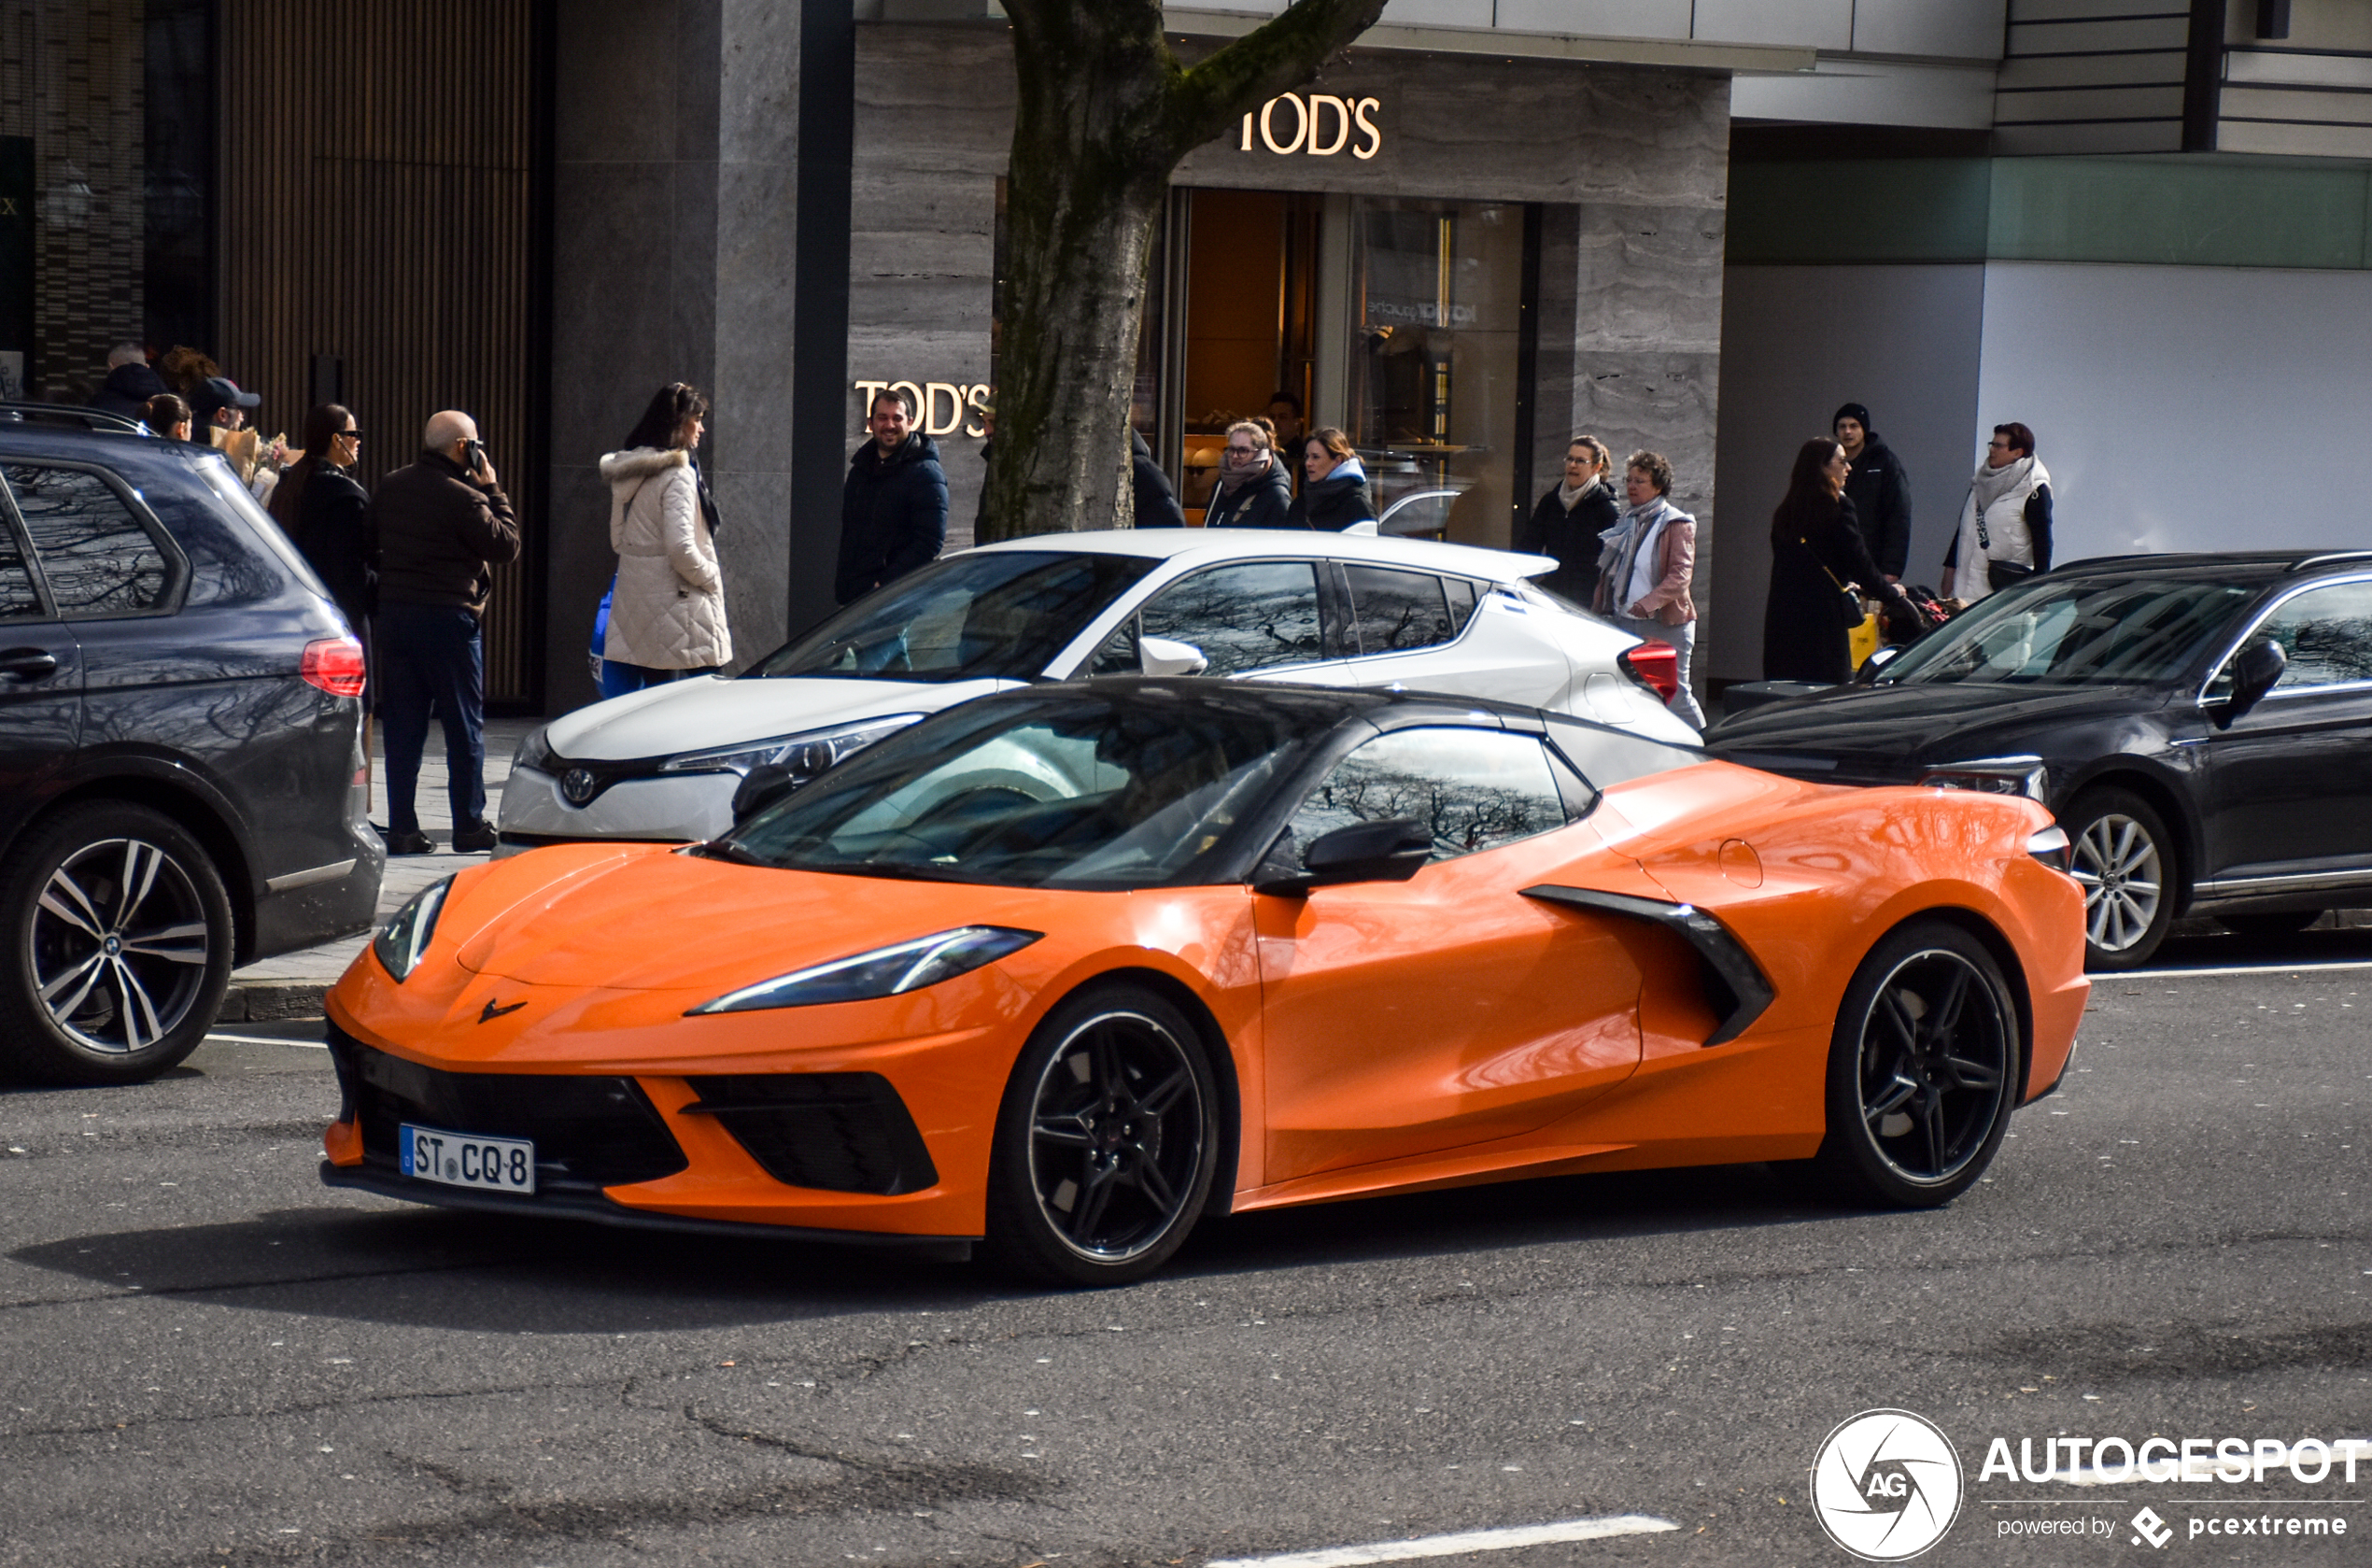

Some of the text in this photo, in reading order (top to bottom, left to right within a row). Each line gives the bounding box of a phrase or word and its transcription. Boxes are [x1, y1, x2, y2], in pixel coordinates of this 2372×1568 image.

[0, 197, 19, 215] X
[854, 380, 991, 437] TOD'S
[416, 1135, 444, 1176] ST
